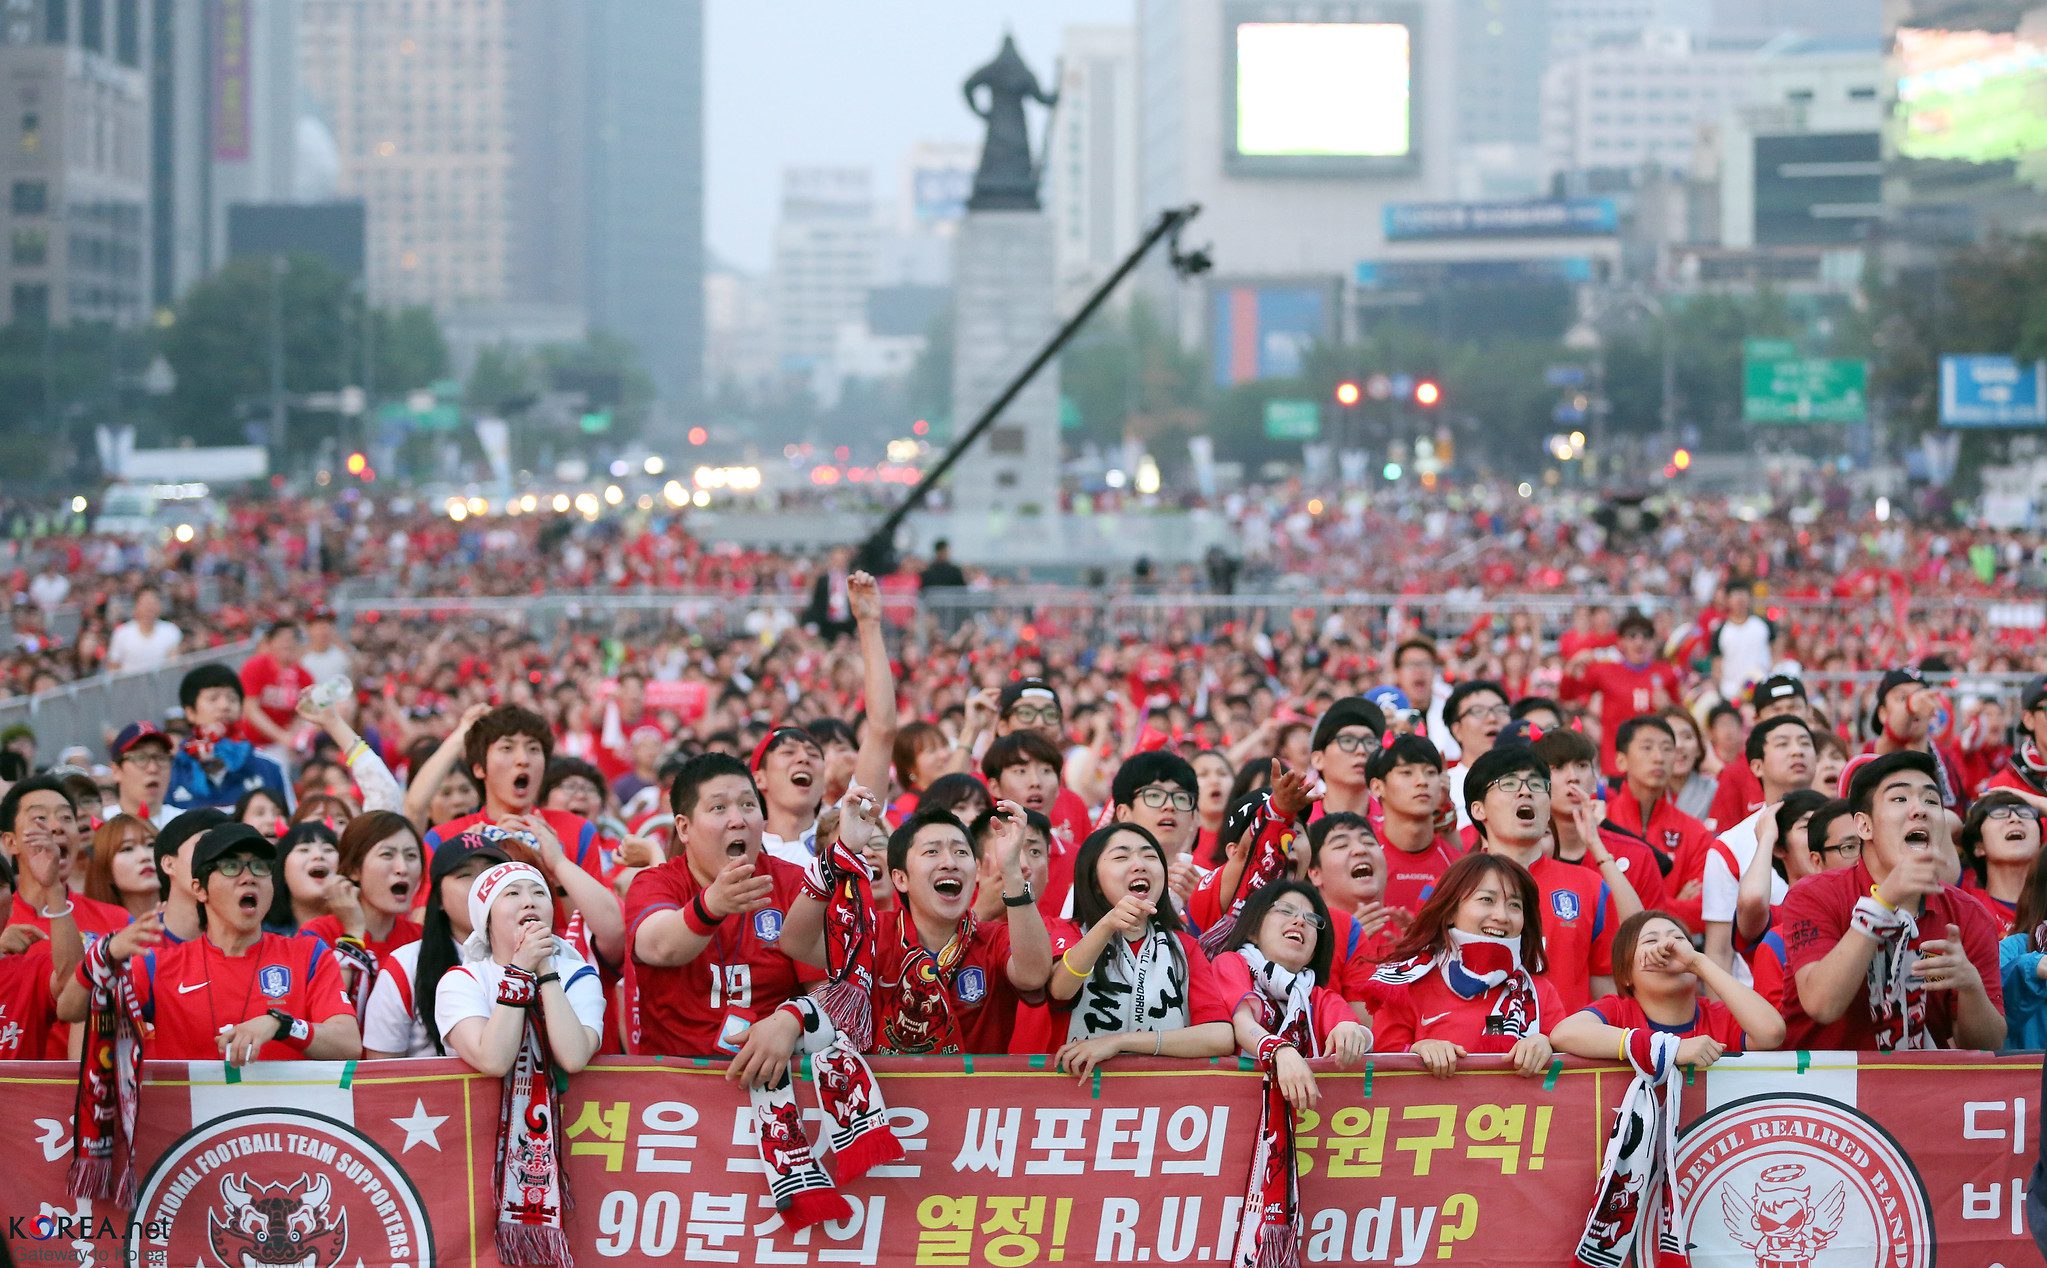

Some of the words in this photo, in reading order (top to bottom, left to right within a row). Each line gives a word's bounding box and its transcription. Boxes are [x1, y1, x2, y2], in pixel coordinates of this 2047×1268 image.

[710, 963, 752, 1008] 19
[560, 1101, 699, 1173] 석은
[951, 1105, 1230, 1178] 써포터의
[195, 1132, 283, 1174] FOOTBALL
[287, 1133, 338, 1165] TEAM
[336, 1152, 410, 1259] SUPPORTERS
[916, 1194, 1073, 1267] 열정!
[1750, 1120, 1870, 1168] REALRED
[1869, 1170, 1909, 1268] BAND
